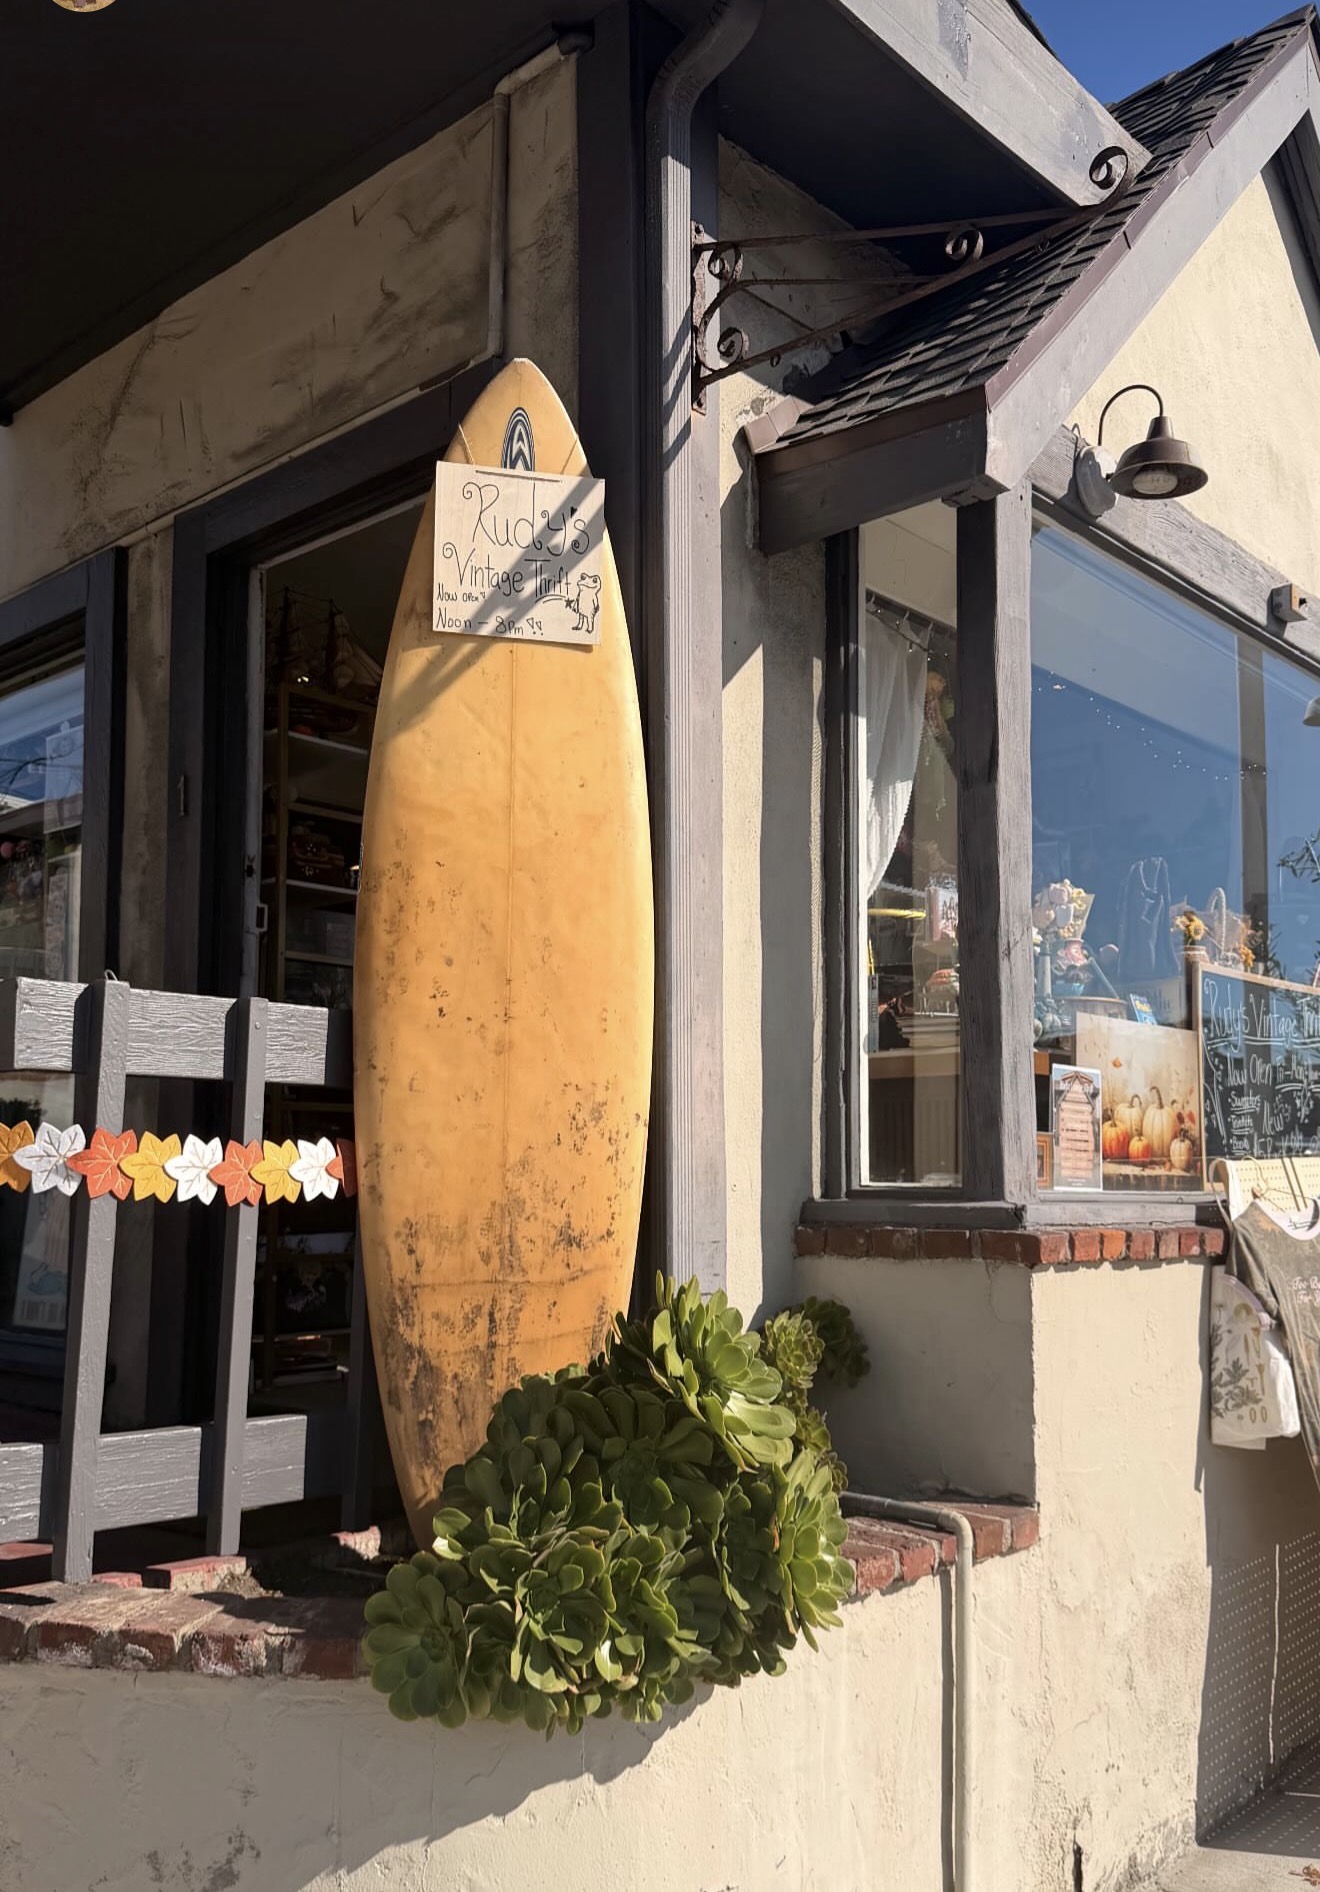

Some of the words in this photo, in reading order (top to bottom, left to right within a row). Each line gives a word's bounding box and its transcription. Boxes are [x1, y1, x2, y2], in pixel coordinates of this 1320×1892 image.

[463, 478, 590, 556] Rudy's
[437, 582, 458, 602] Now
[442, 542, 525, 597] Vintage
[524, 558, 572, 598] Thrift
[436, 607, 472, 629] Noon
[1250, 993, 1298, 1049] Vintage
[1226, 1052, 1247, 1087] Now
